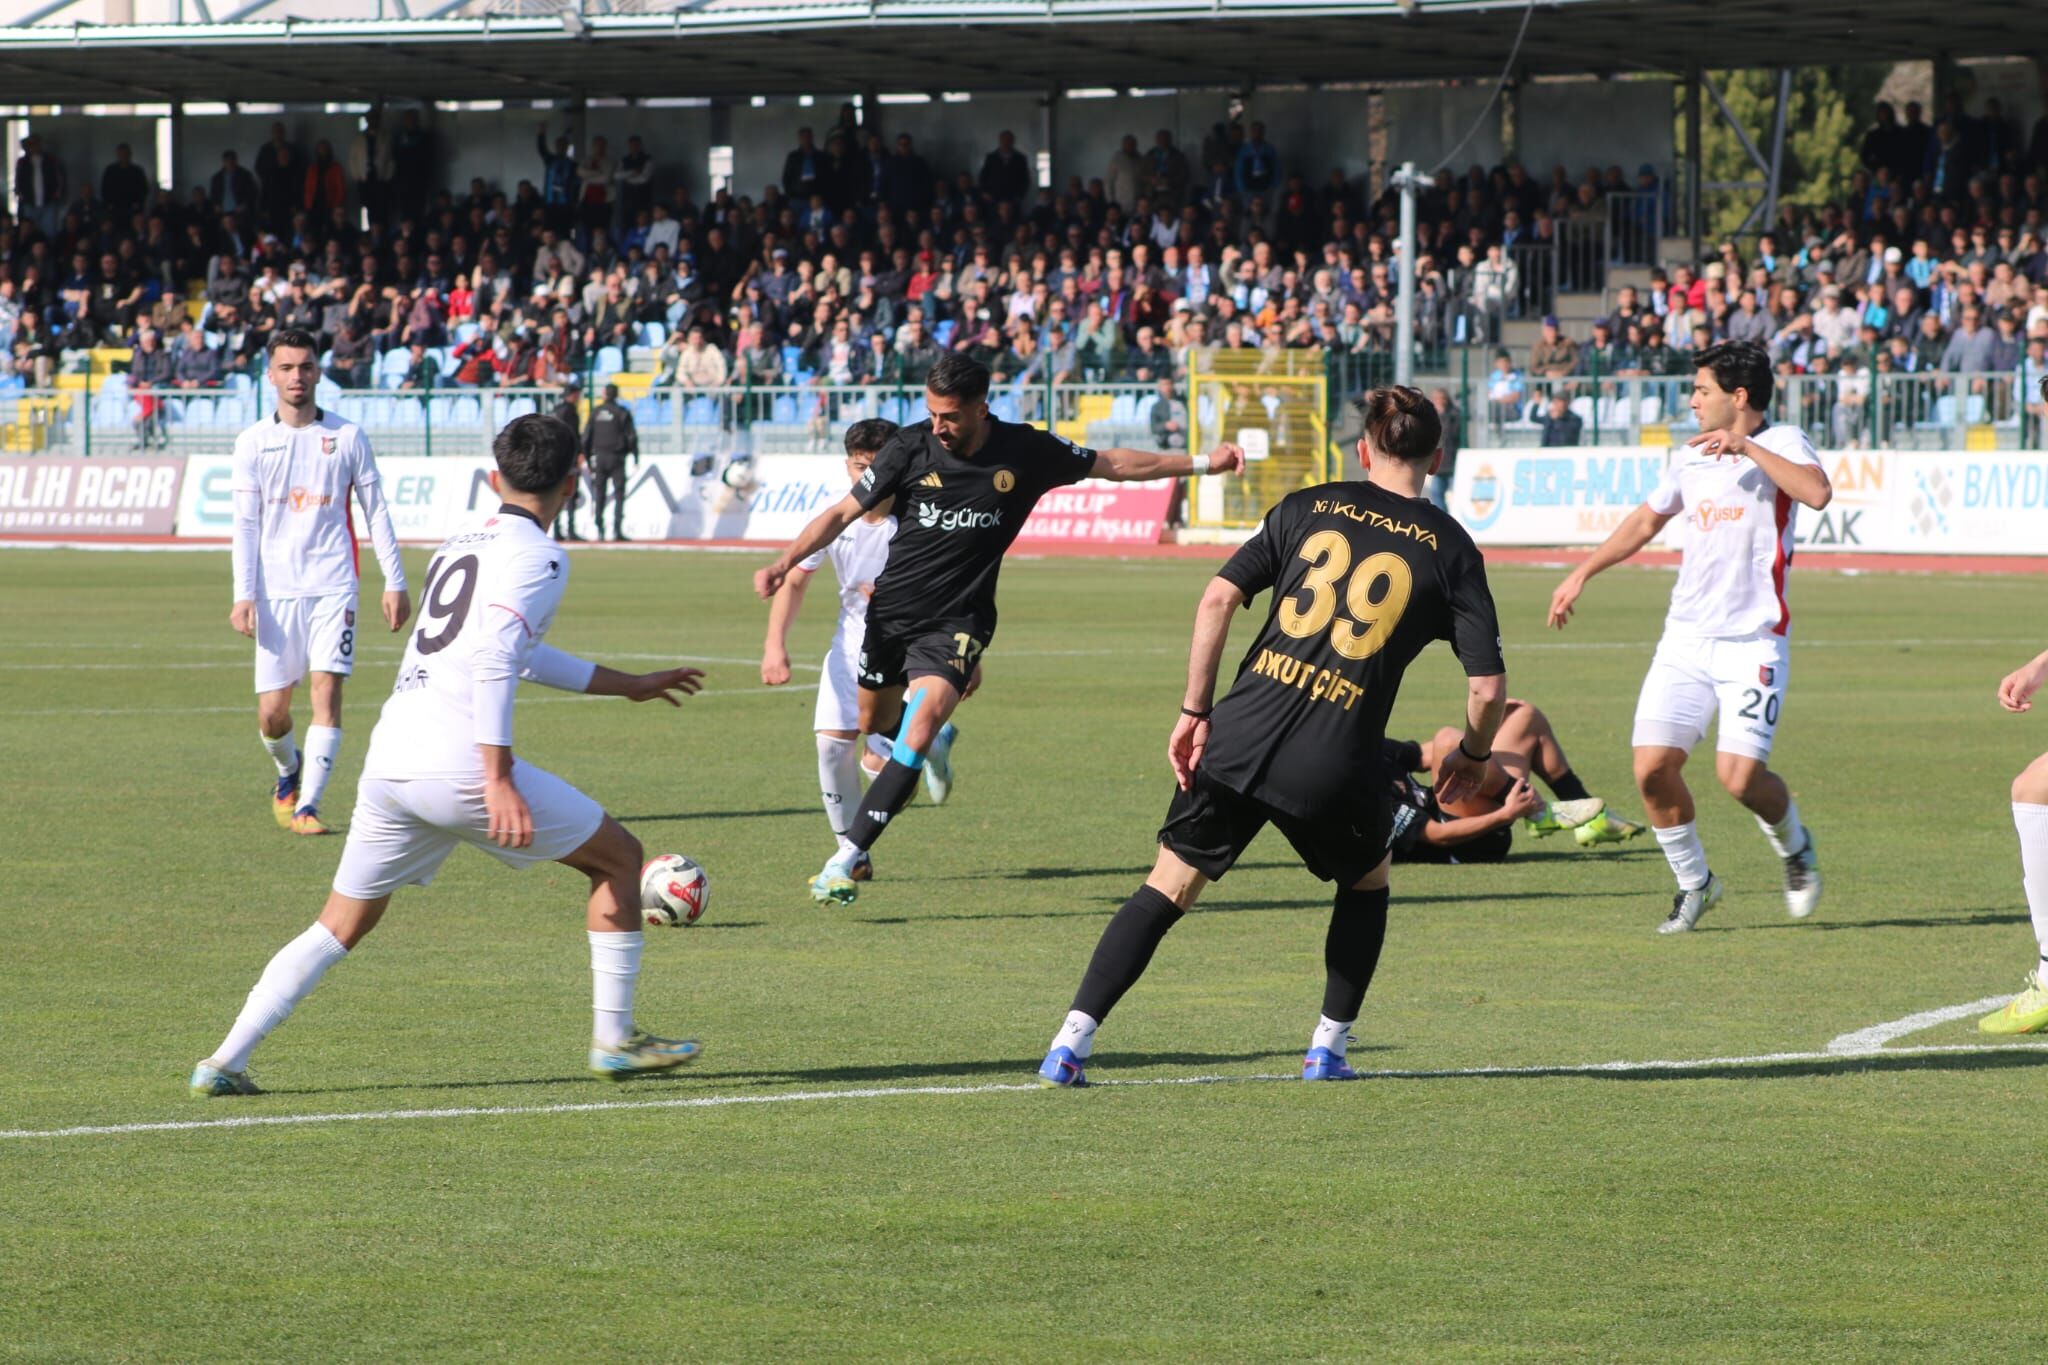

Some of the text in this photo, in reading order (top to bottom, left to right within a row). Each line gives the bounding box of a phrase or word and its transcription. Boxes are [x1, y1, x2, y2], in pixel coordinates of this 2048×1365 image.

[75, 465, 176, 508] ACAR
[1963, 462, 2048, 508] BAYD
[941, 507, 1003, 531] gürok
[416, 554, 479, 655] 19
[1278, 529, 1413, 660] 39
[339, 629, 353, 656] 8
[1310, 668, 1364, 711] ÇİFT
[1738, 687, 1779, 727] 20
